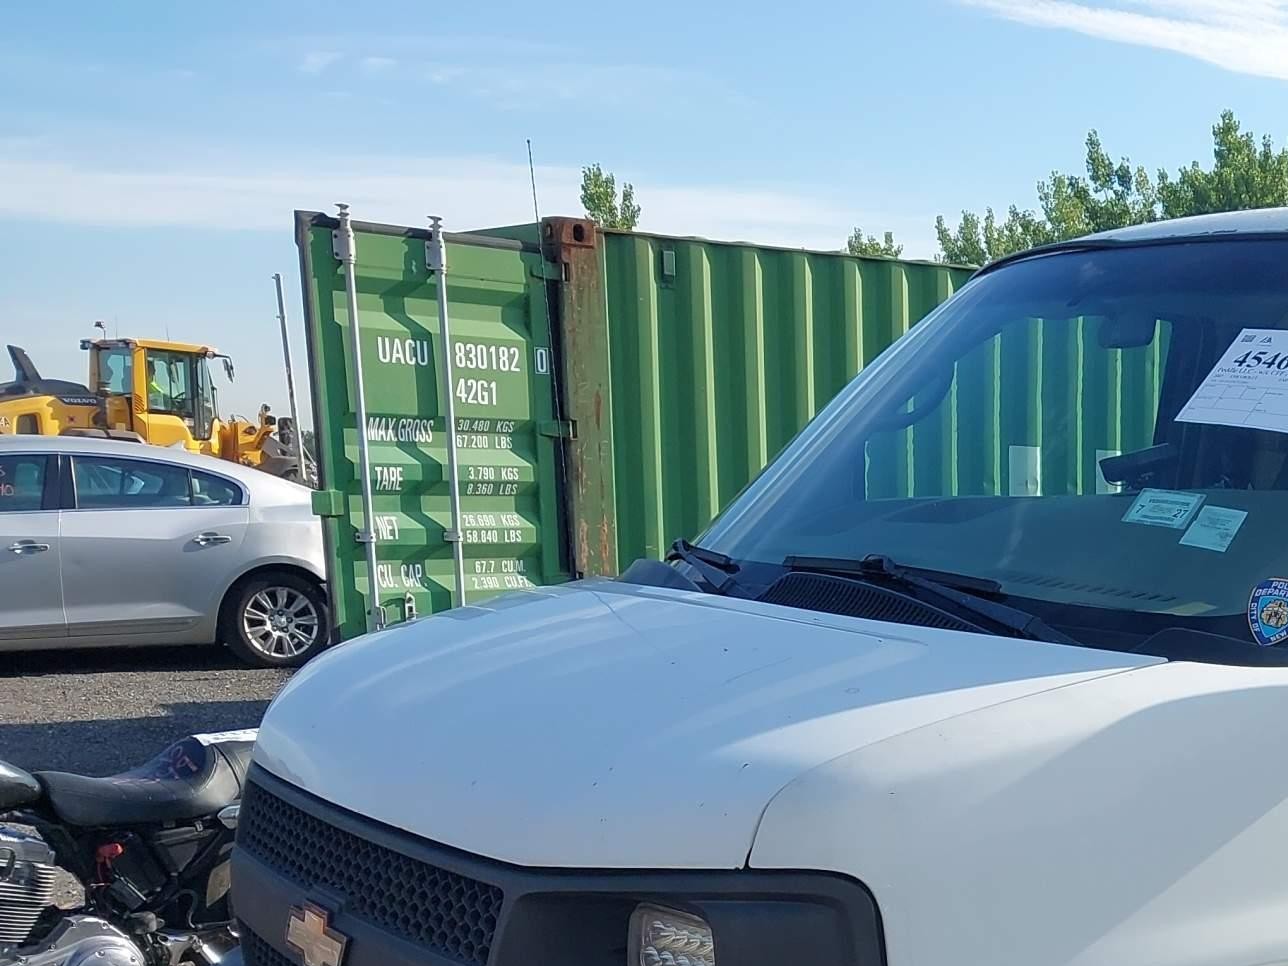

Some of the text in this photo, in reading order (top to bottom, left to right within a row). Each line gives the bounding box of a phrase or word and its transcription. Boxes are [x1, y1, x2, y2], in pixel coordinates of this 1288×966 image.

[377, 336, 547, 373] UACU 830182 0
[456, 378, 497, 406] 42G1
[457, 420, 490, 432] 30.480
[496, 421, 514, 433] KGS
[456, 435, 513, 449] 67.200 LBS
[375, 467, 519, 491] TARE 3.790 KGS
[467, 483, 518, 495] 8.360 LBS
[1136, 505, 1145, 513] 7
[1172, 509, 1189, 519] 27
[375, 514, 520, 540] NET 26.690 KGS
[466, 530, 522, 543] 58.840 LBS
[377, 565, 398, 588] CU.
[401, 564, 428, 587] CAP.
[475, 560, 495, 573] 67.7
[472, 577, 499, 589] 2.390
[1252, 623, 1260, 632] OF
[1270, 630, 1287, 642] NEW
